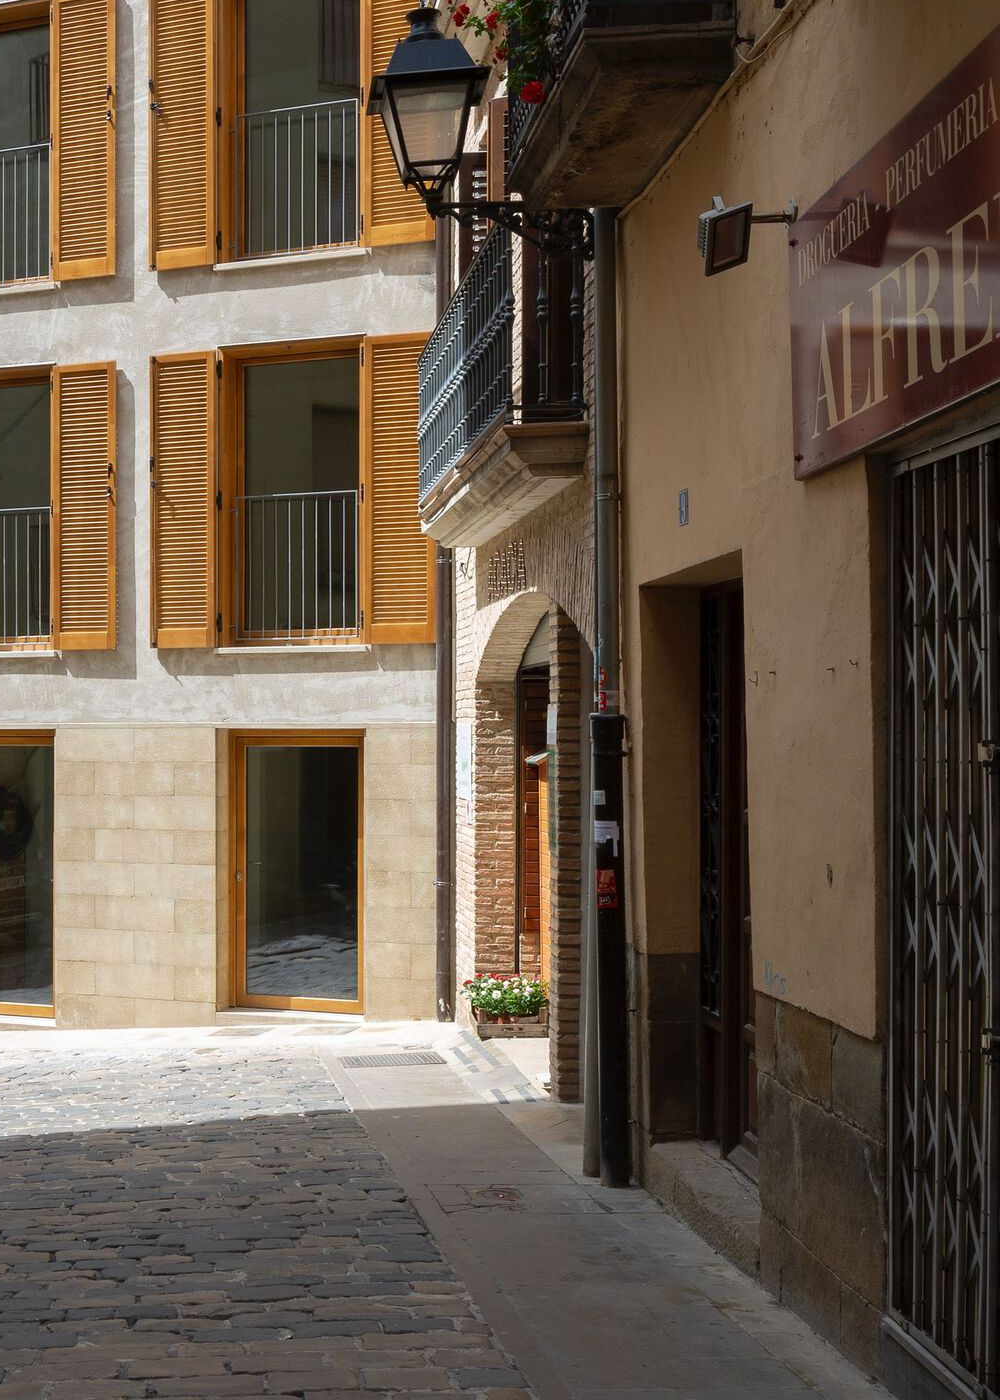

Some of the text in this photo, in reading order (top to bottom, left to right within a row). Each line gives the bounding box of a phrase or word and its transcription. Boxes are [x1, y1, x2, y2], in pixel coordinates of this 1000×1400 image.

[797, 191, 871, 287] DROGUERIA
[884, 75, 999, 214] PERFUMERIA
[810, 191, 1000, 440] ALFRE
